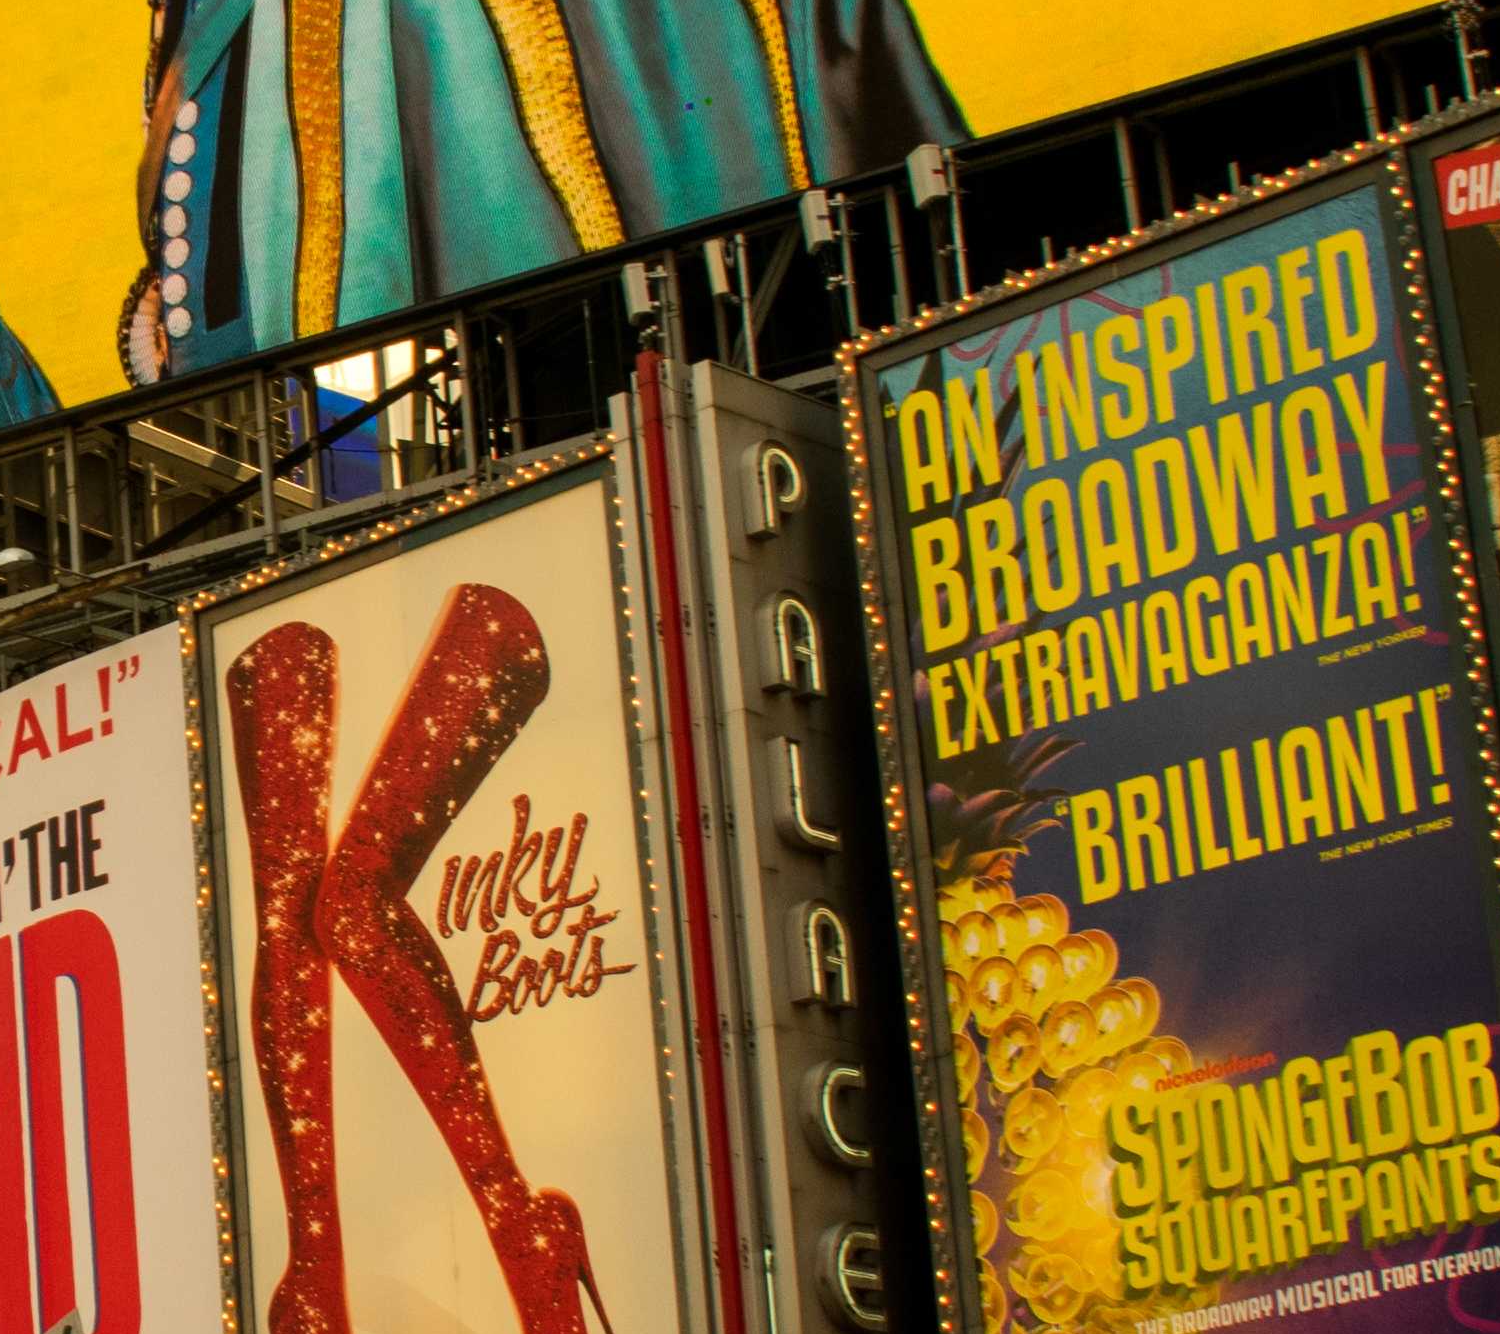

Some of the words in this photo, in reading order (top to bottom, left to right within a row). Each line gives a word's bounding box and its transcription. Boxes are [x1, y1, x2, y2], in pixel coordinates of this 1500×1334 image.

[1016, 229, 1388, 472] INSPIRED
[911, 362, 1392, 654] BROADWAY
[1318, 651, 1342, 666] THE
[1344, 641, 1374, 659] NEW
[1376, 624, 1428, 649] YORKER
[18, 798, 110, 912] THE
[1319, 847, 1344, 863] THE
[1345, 838, 1376, 855] NEW
[1378, 827, 1414, 845] YORK
[1415, 817, 1454, 836] TIMES
[468, 905, 637, 1024] Boots
[1156, 1050, 1278, 1093] nickelodeon
[1275, 1268, 1380, 1316] MUSICAL
[1381, 1267, 1418, 1293] FOR
